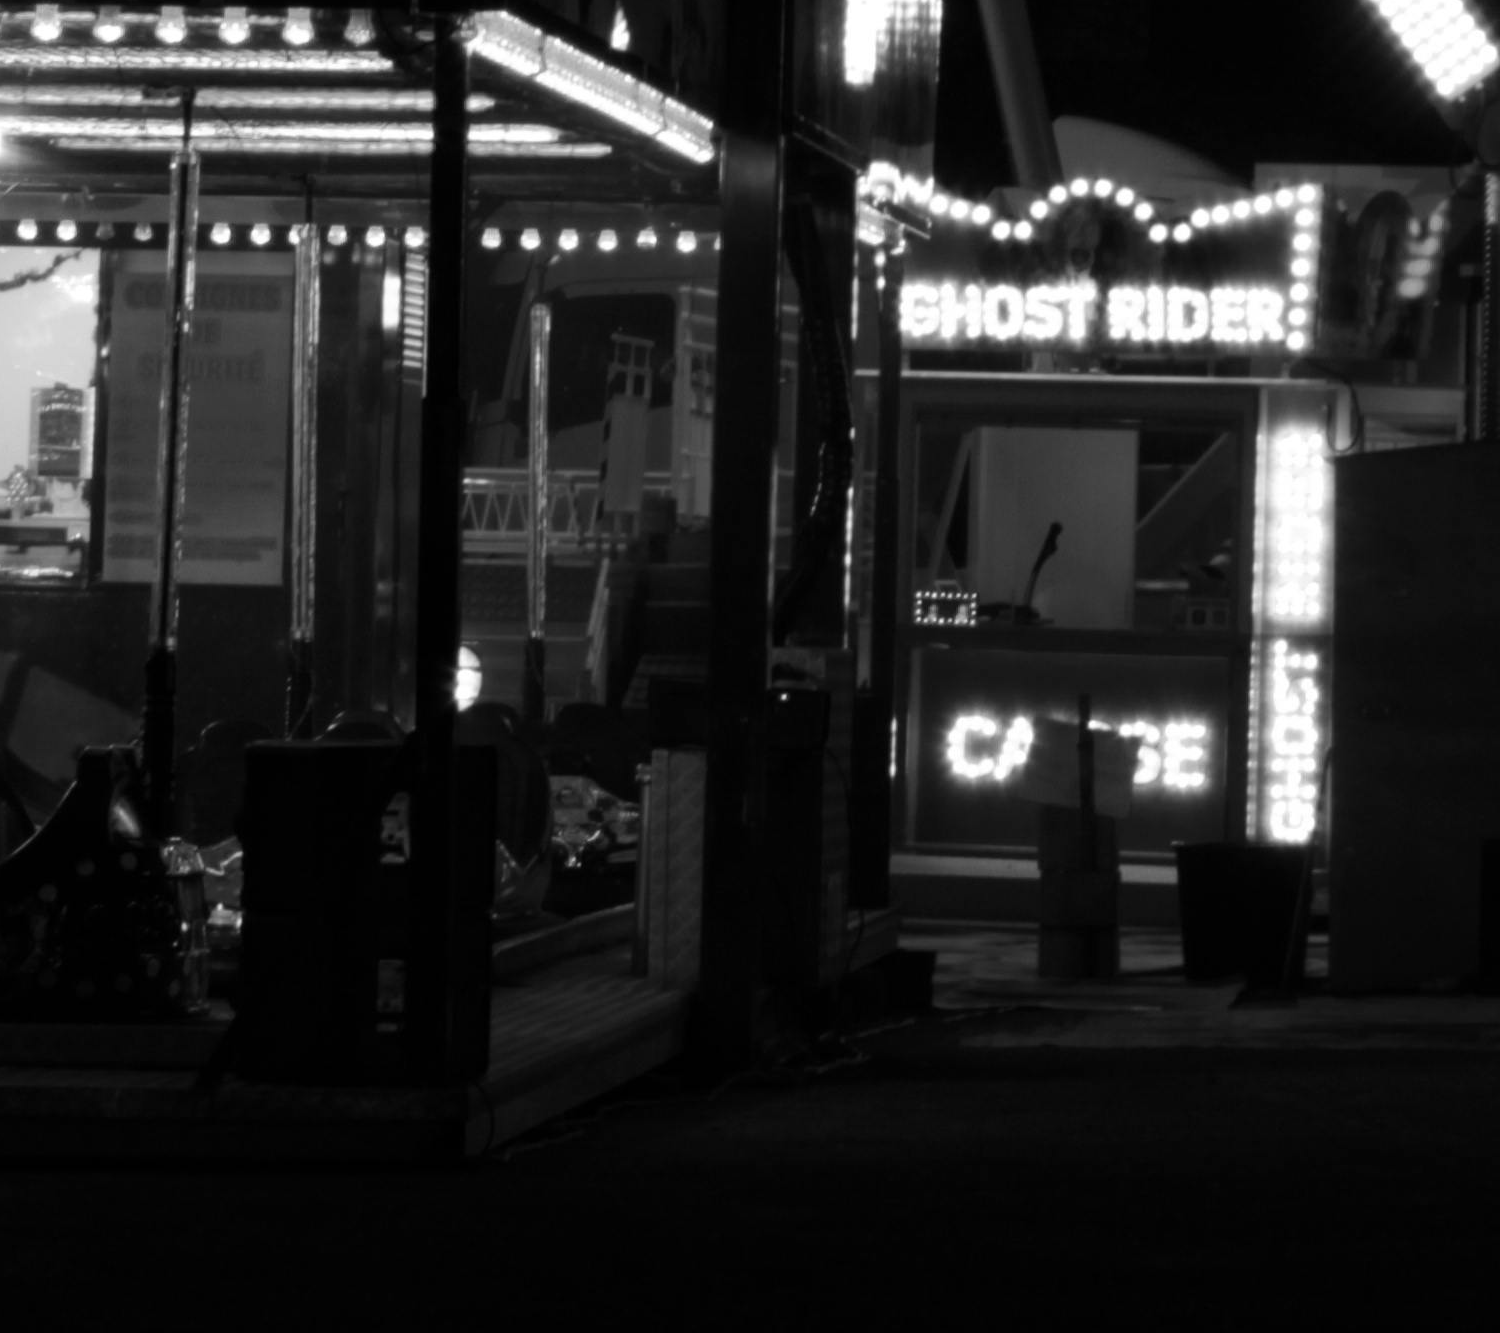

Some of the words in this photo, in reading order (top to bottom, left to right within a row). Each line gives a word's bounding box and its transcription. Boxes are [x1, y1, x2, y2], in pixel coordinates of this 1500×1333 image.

[899, 283, 1097, 340] GHOST
[1107, 284, 1286, 343] RIDER
[1269, 638, 1321, 844] GHOST
